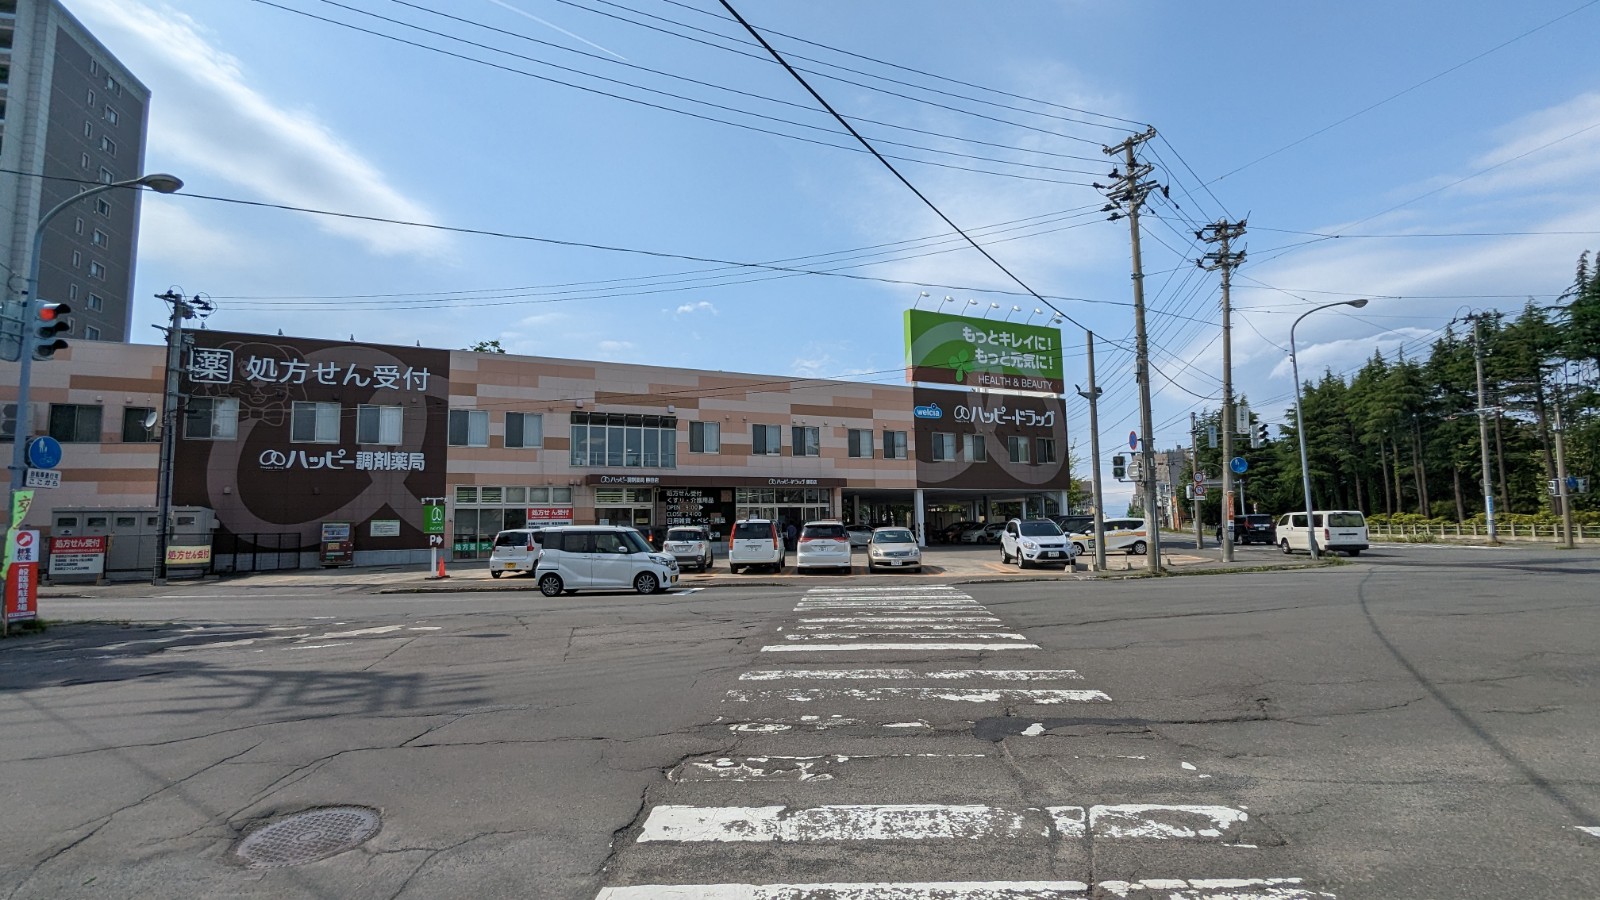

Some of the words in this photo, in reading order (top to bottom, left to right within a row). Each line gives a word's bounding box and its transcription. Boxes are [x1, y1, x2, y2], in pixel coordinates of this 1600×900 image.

[196, 351, 229, 380] 薬
[246, 355, 431, 391] 処方せん受付
[978, 375, 1011, 386] HEALTH
[1013, 378, 1020, 387] &
[1021, 379, 1053, 390] BEAUTY
[916, 406, 940, 417] welcia
[286, 449, 425, 471] ハッピー調剤薬局
[29, 478, 58, 487] ここから
[55, 538, 100, 548] 処方せん受付
[429, 534, 436, 546] P
[168, 549, 210, 560] 処方せん受付
